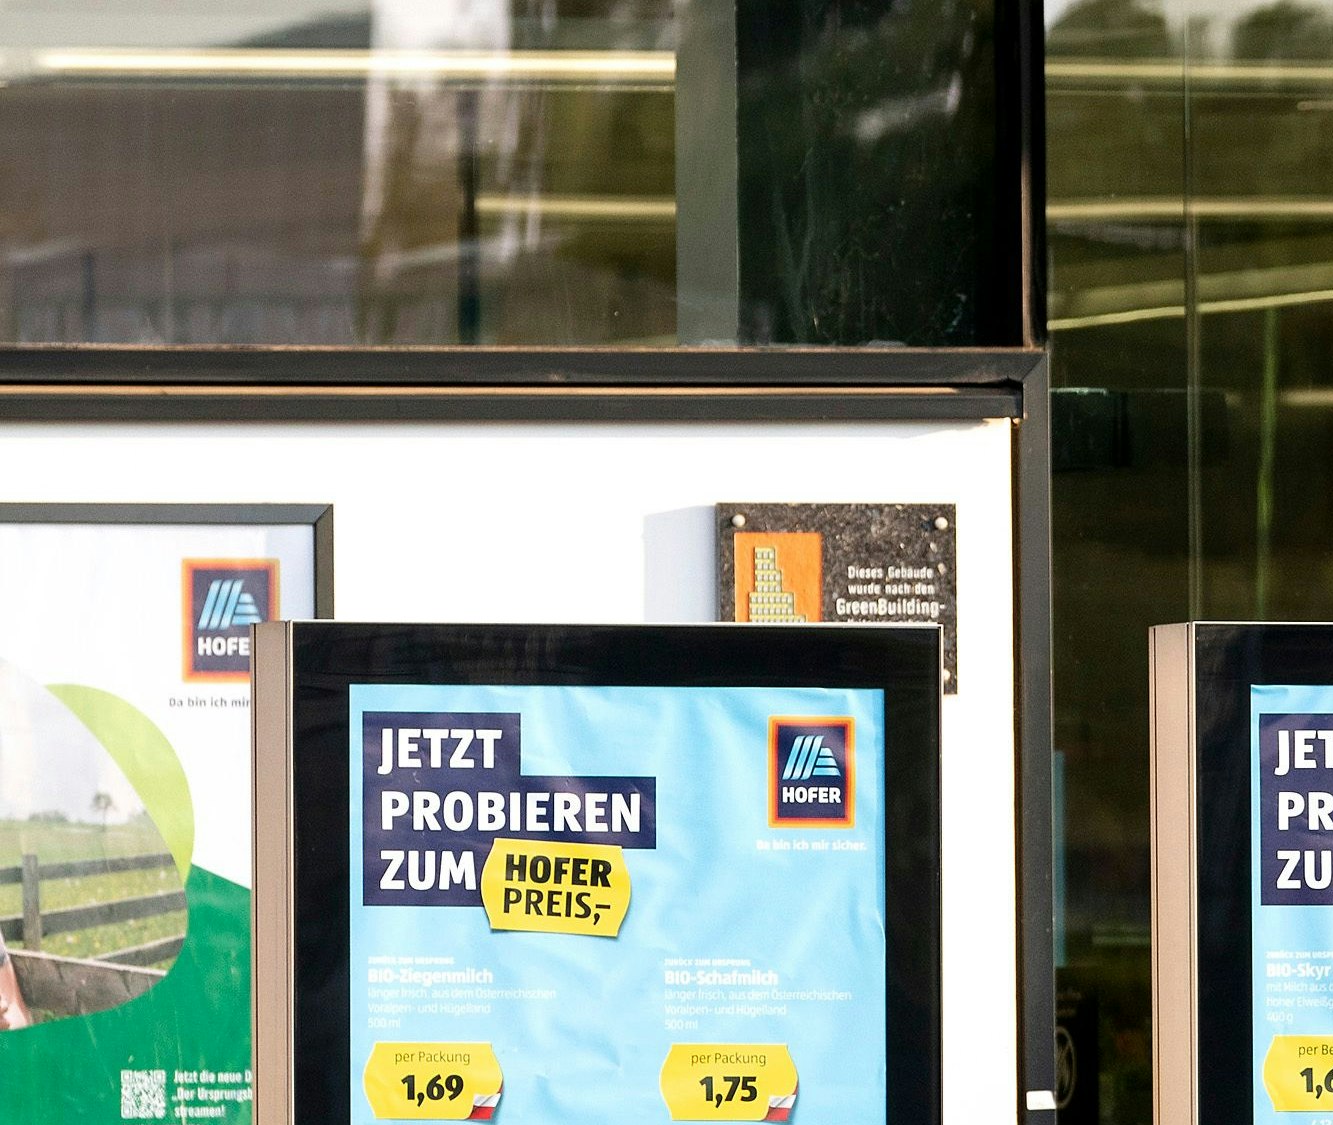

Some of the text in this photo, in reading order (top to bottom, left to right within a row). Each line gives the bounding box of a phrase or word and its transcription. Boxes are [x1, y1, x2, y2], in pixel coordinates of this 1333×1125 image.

[847, 565, 883, 579] Dieses
[847, 582, 935, 595] wurde nach den
[835, 597, 946, 619] GreenBuilding-
[197, 636, 251, 656] HOFE
[187, 696, 206, 708] bin
[210, 696, 227, 708] ich
[377, 727, 502, 775] JETZT
[781, 786, 841, 803] HOFER
[380, 790, 641, 833] PROBIEREN
[379, 849, 477, 891] ZUM
[505, 853, 611, 888] HOFER
[367, 968, 493, 987] BIO-Ziegenmilch
[664, 970, 779, 986] BIO-Schafmilch
[1266, 963, 1331, 979] BIO-Skyr
[394, 1050, 471, 1065] per Packung
[691, 1052, 767, 1066] per Packung
[1298, 1046, 1318, 1057] per
[401, 1074, 464, 1107] 1,69
[699, 1076, 758, 1109] 1,75
